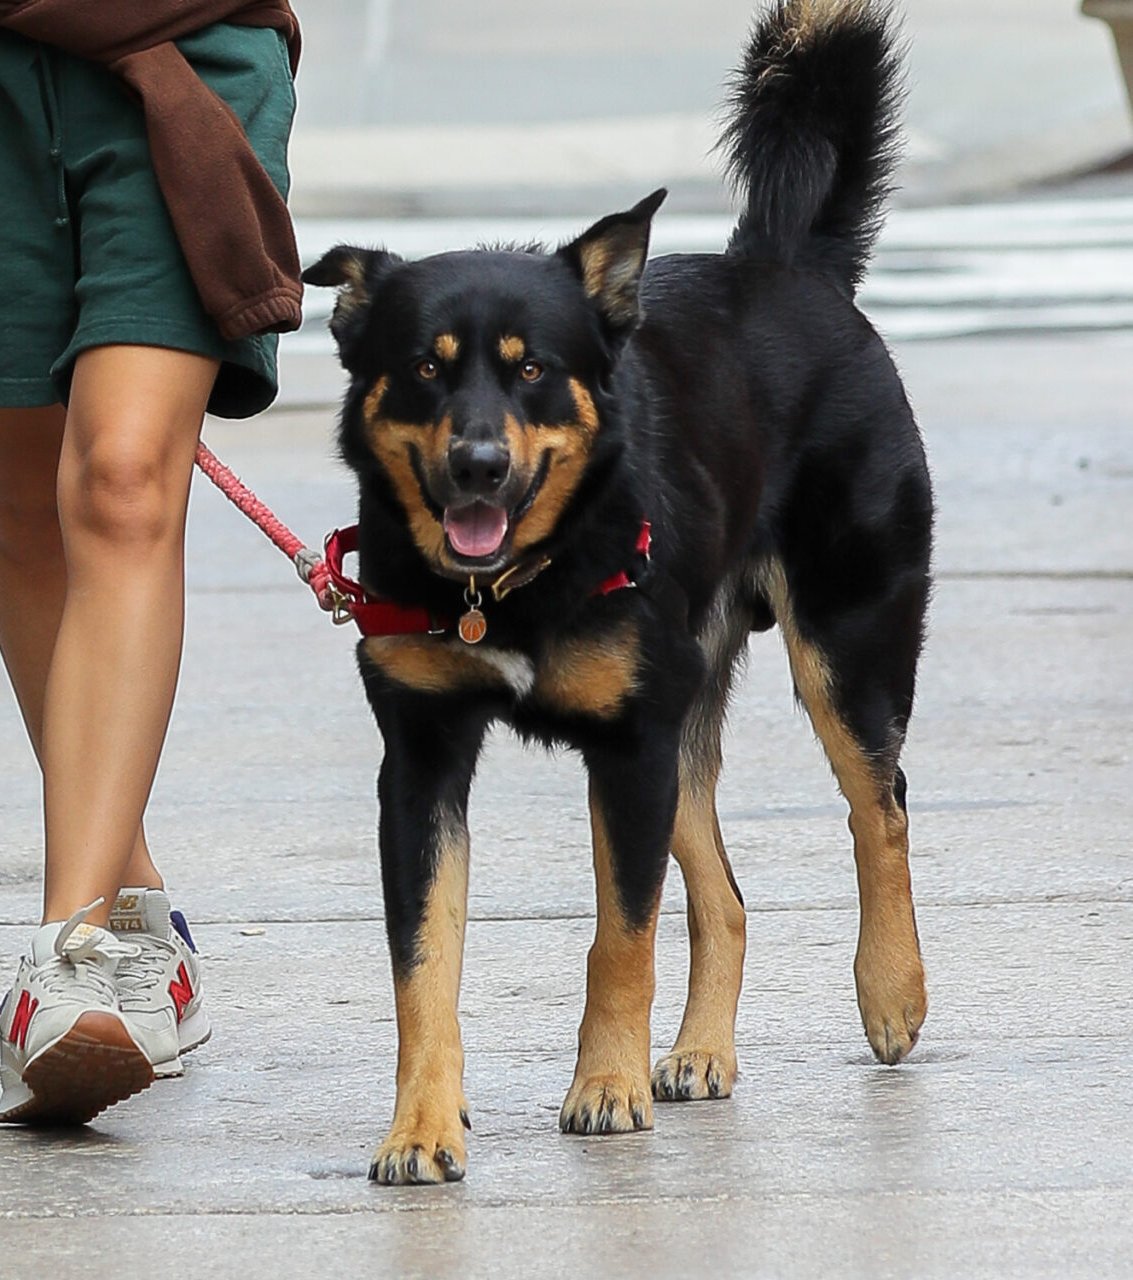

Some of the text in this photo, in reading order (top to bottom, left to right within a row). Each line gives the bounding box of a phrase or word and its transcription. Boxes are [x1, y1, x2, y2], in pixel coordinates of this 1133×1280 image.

[112, 919, 140, 930] 574
[8, 988, 39, 1050] N
[169, 960, 194, 1024] N
